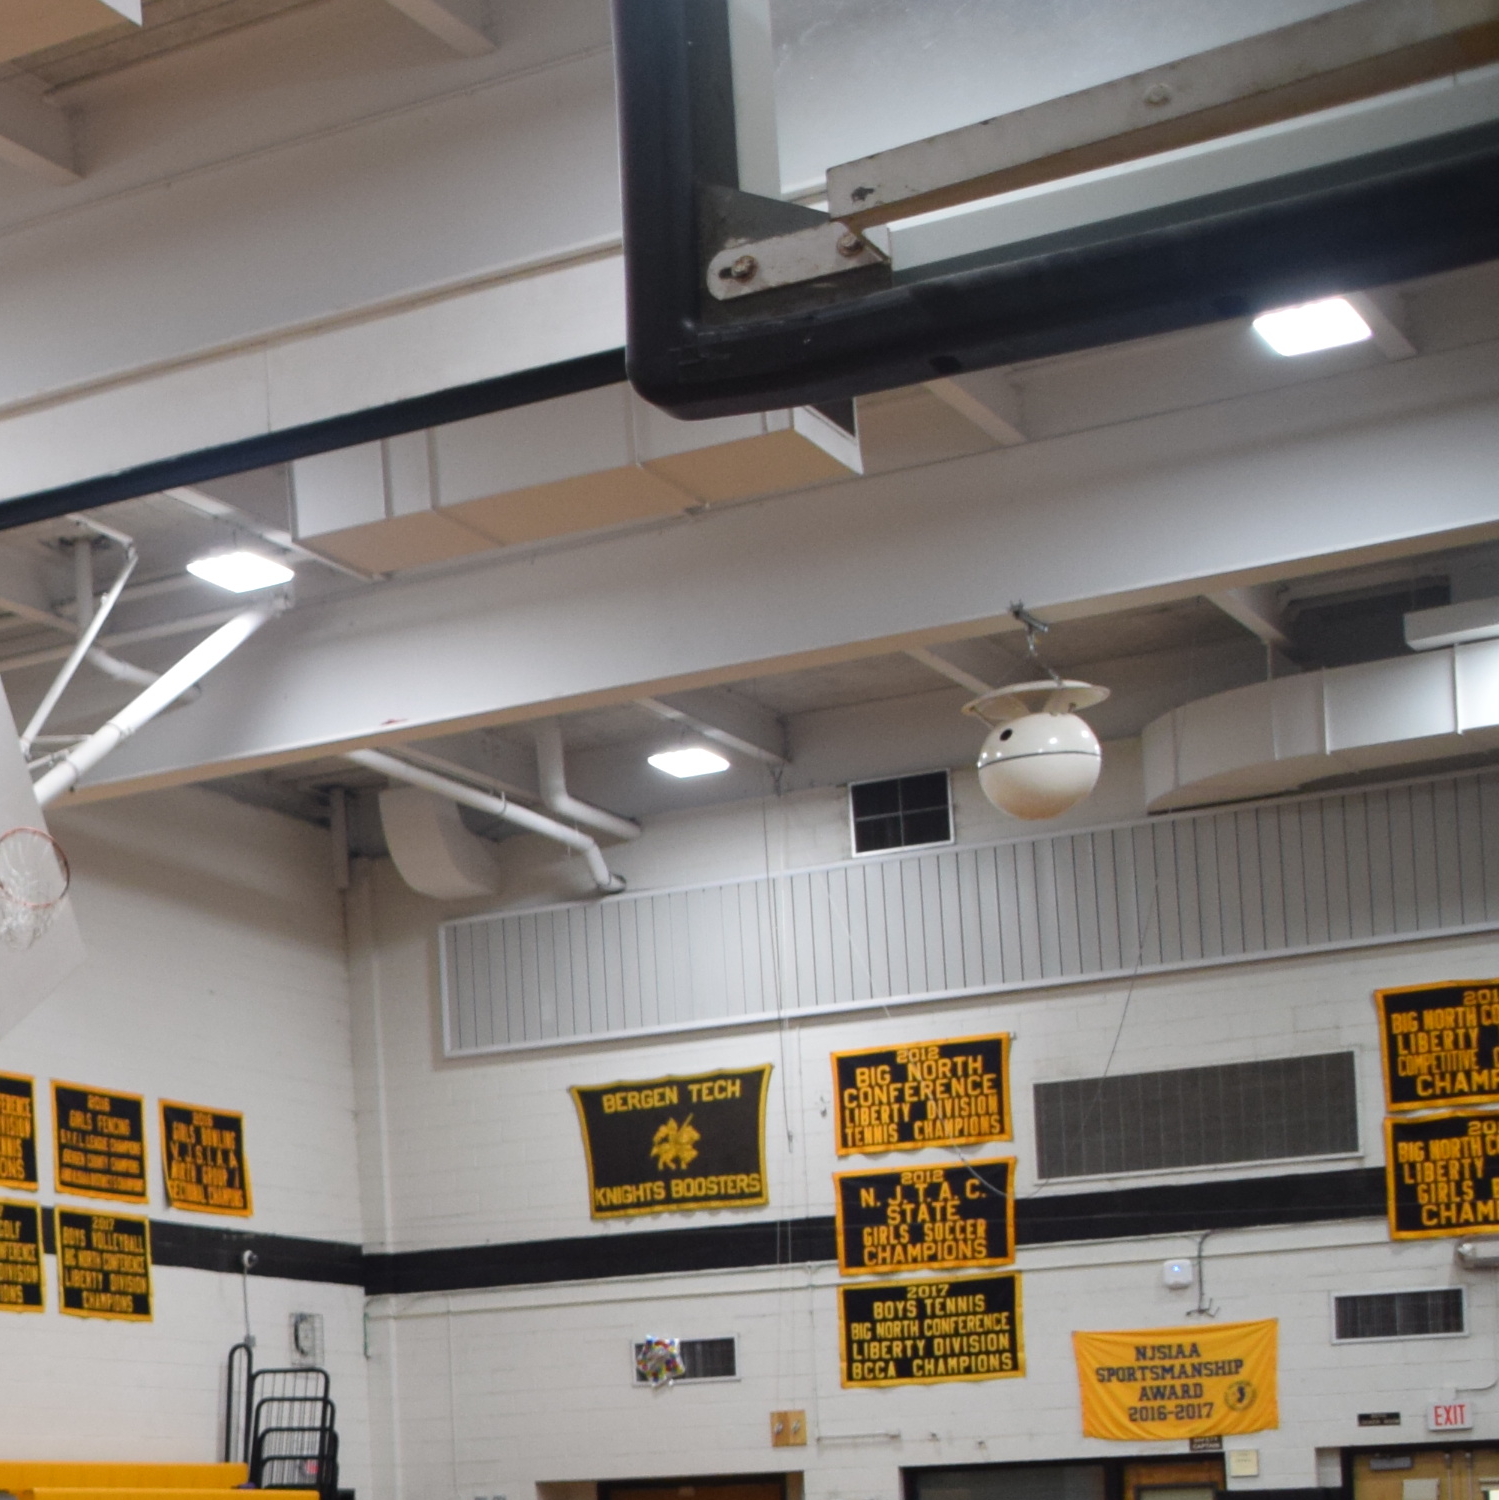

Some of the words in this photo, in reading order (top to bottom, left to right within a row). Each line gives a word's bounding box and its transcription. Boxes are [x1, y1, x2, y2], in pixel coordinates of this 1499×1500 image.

[1391, 1012, 1418, 1034] BIG
[1424, 1006, 1477, 1030] NORTH
[896, 1046, 939, 1063] 2012
[1397, 1028, 1479, 1055] LIBERTY
[856, 1065, 891, 1088] BIG
[907, 1055, 983, 1082] NORTH
[603, 1085, 678, 1113] BERGEN
[688, 1079, 741, 1102] TECH
[844, 1074, 997, 1108] CONFERENCE
[846, 1103, 911, 1127] LIBERTY
[927, 1094, 998, 1120] DIVISION
[846, 1125, 898, 1147] TENNIS
[914, 1116, 1000, 1140] CHAMPIONS
[1398, 1141, 1424, 1162] BIG
[1429, 1136, 1482, 1159] NORTH
[901, 1170, 944, 1184] 2012
[1404, 1157, 1483, 1184] LIBERTY
[595, 1181, 666, 1206] KNIGHTS
[671, 1173, 761, 1198] BOOSTERS
[1418, 1180, 1474, 1204] GIRLS
[887, 1200, 961, 1225] STATE
[863, 1225, 909, 1246] GIRLS
[924, 1219, 986, 1241] SOCCER
[864, 1239, 987, 1266] CHAMPIONS
[907, 1284, 949, 1298] 2017
[873, 1300, 917, 1320] BOYS
[924, 1295, 985, 1316] TENNIS
[851, 1322, 871, 1340] BIG
[877, 1320, 919, 1339] NORTH
[924, 1312, 1010, 1336] CONFERENCE
[854, 1339, 926, 1360] LIBERTY
[934, 1334, 1009, 1356] DIVISION
[1135, 1343, 1201, 1361] NJSIAA
[853, 1362, 896, 1379] BCCA
[913, 1353, 1012, 1376] CHAMPIONS
[1096, 1359, 1243, 1383] SPORTSMANSHIP
[1139, 1383, 1203, 1401] AWARD
[1128, 1403, 1214, 1422] 2016-2017
[1434, 1404, 1465, 1426] EXIT
